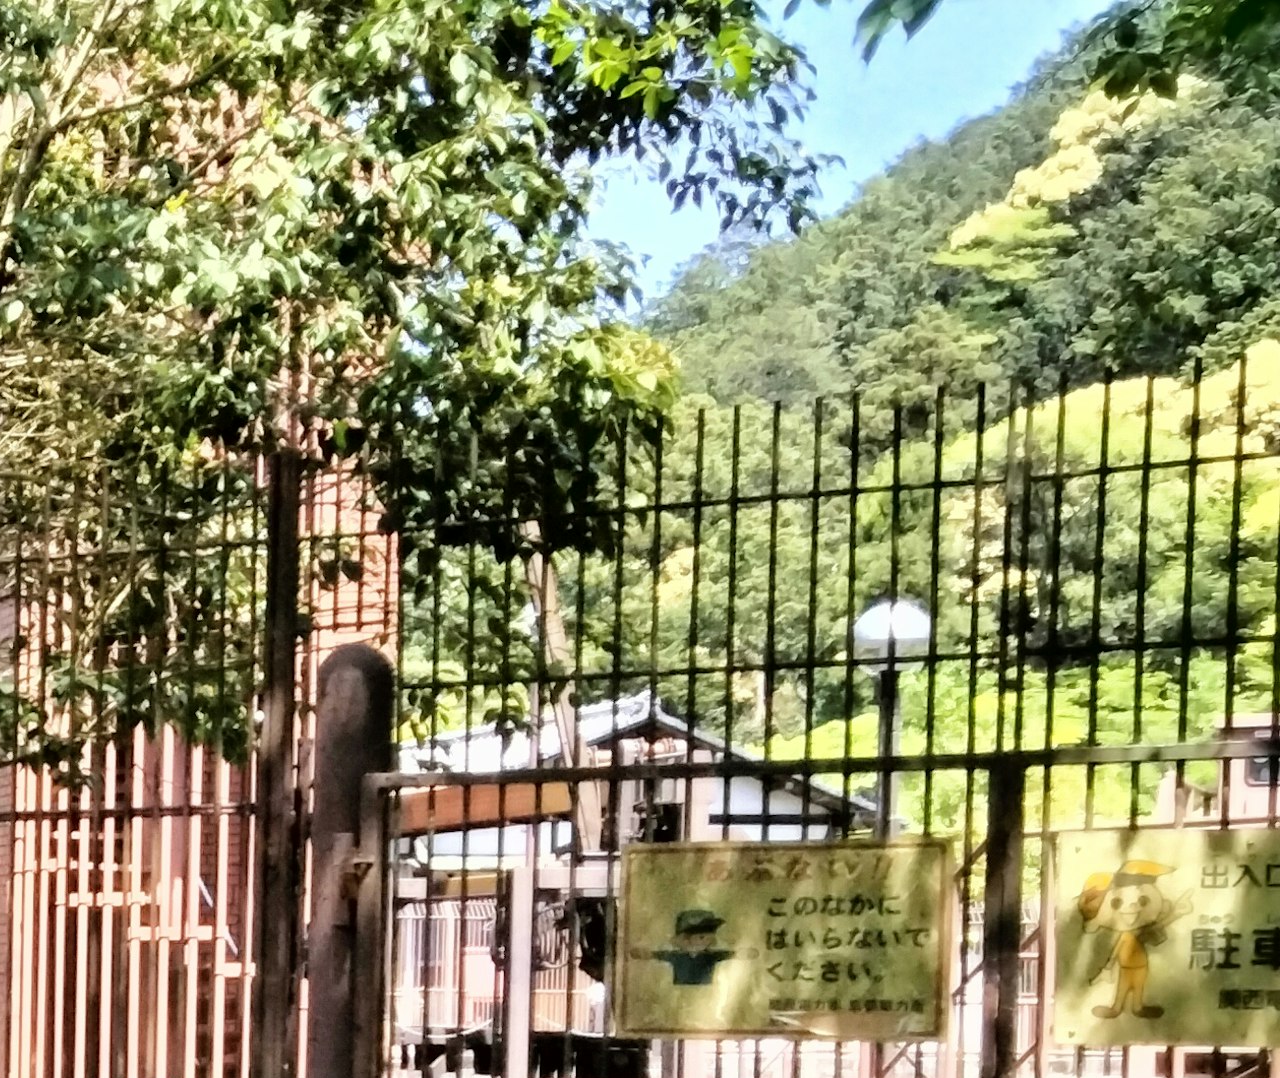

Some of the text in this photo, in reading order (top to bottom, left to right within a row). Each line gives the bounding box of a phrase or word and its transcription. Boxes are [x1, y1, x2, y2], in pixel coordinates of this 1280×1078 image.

[766, 893, 902, 918] このなかに
[766, 927, 930, 951] はいらないで
[767, 960, 886, 984] ください。
